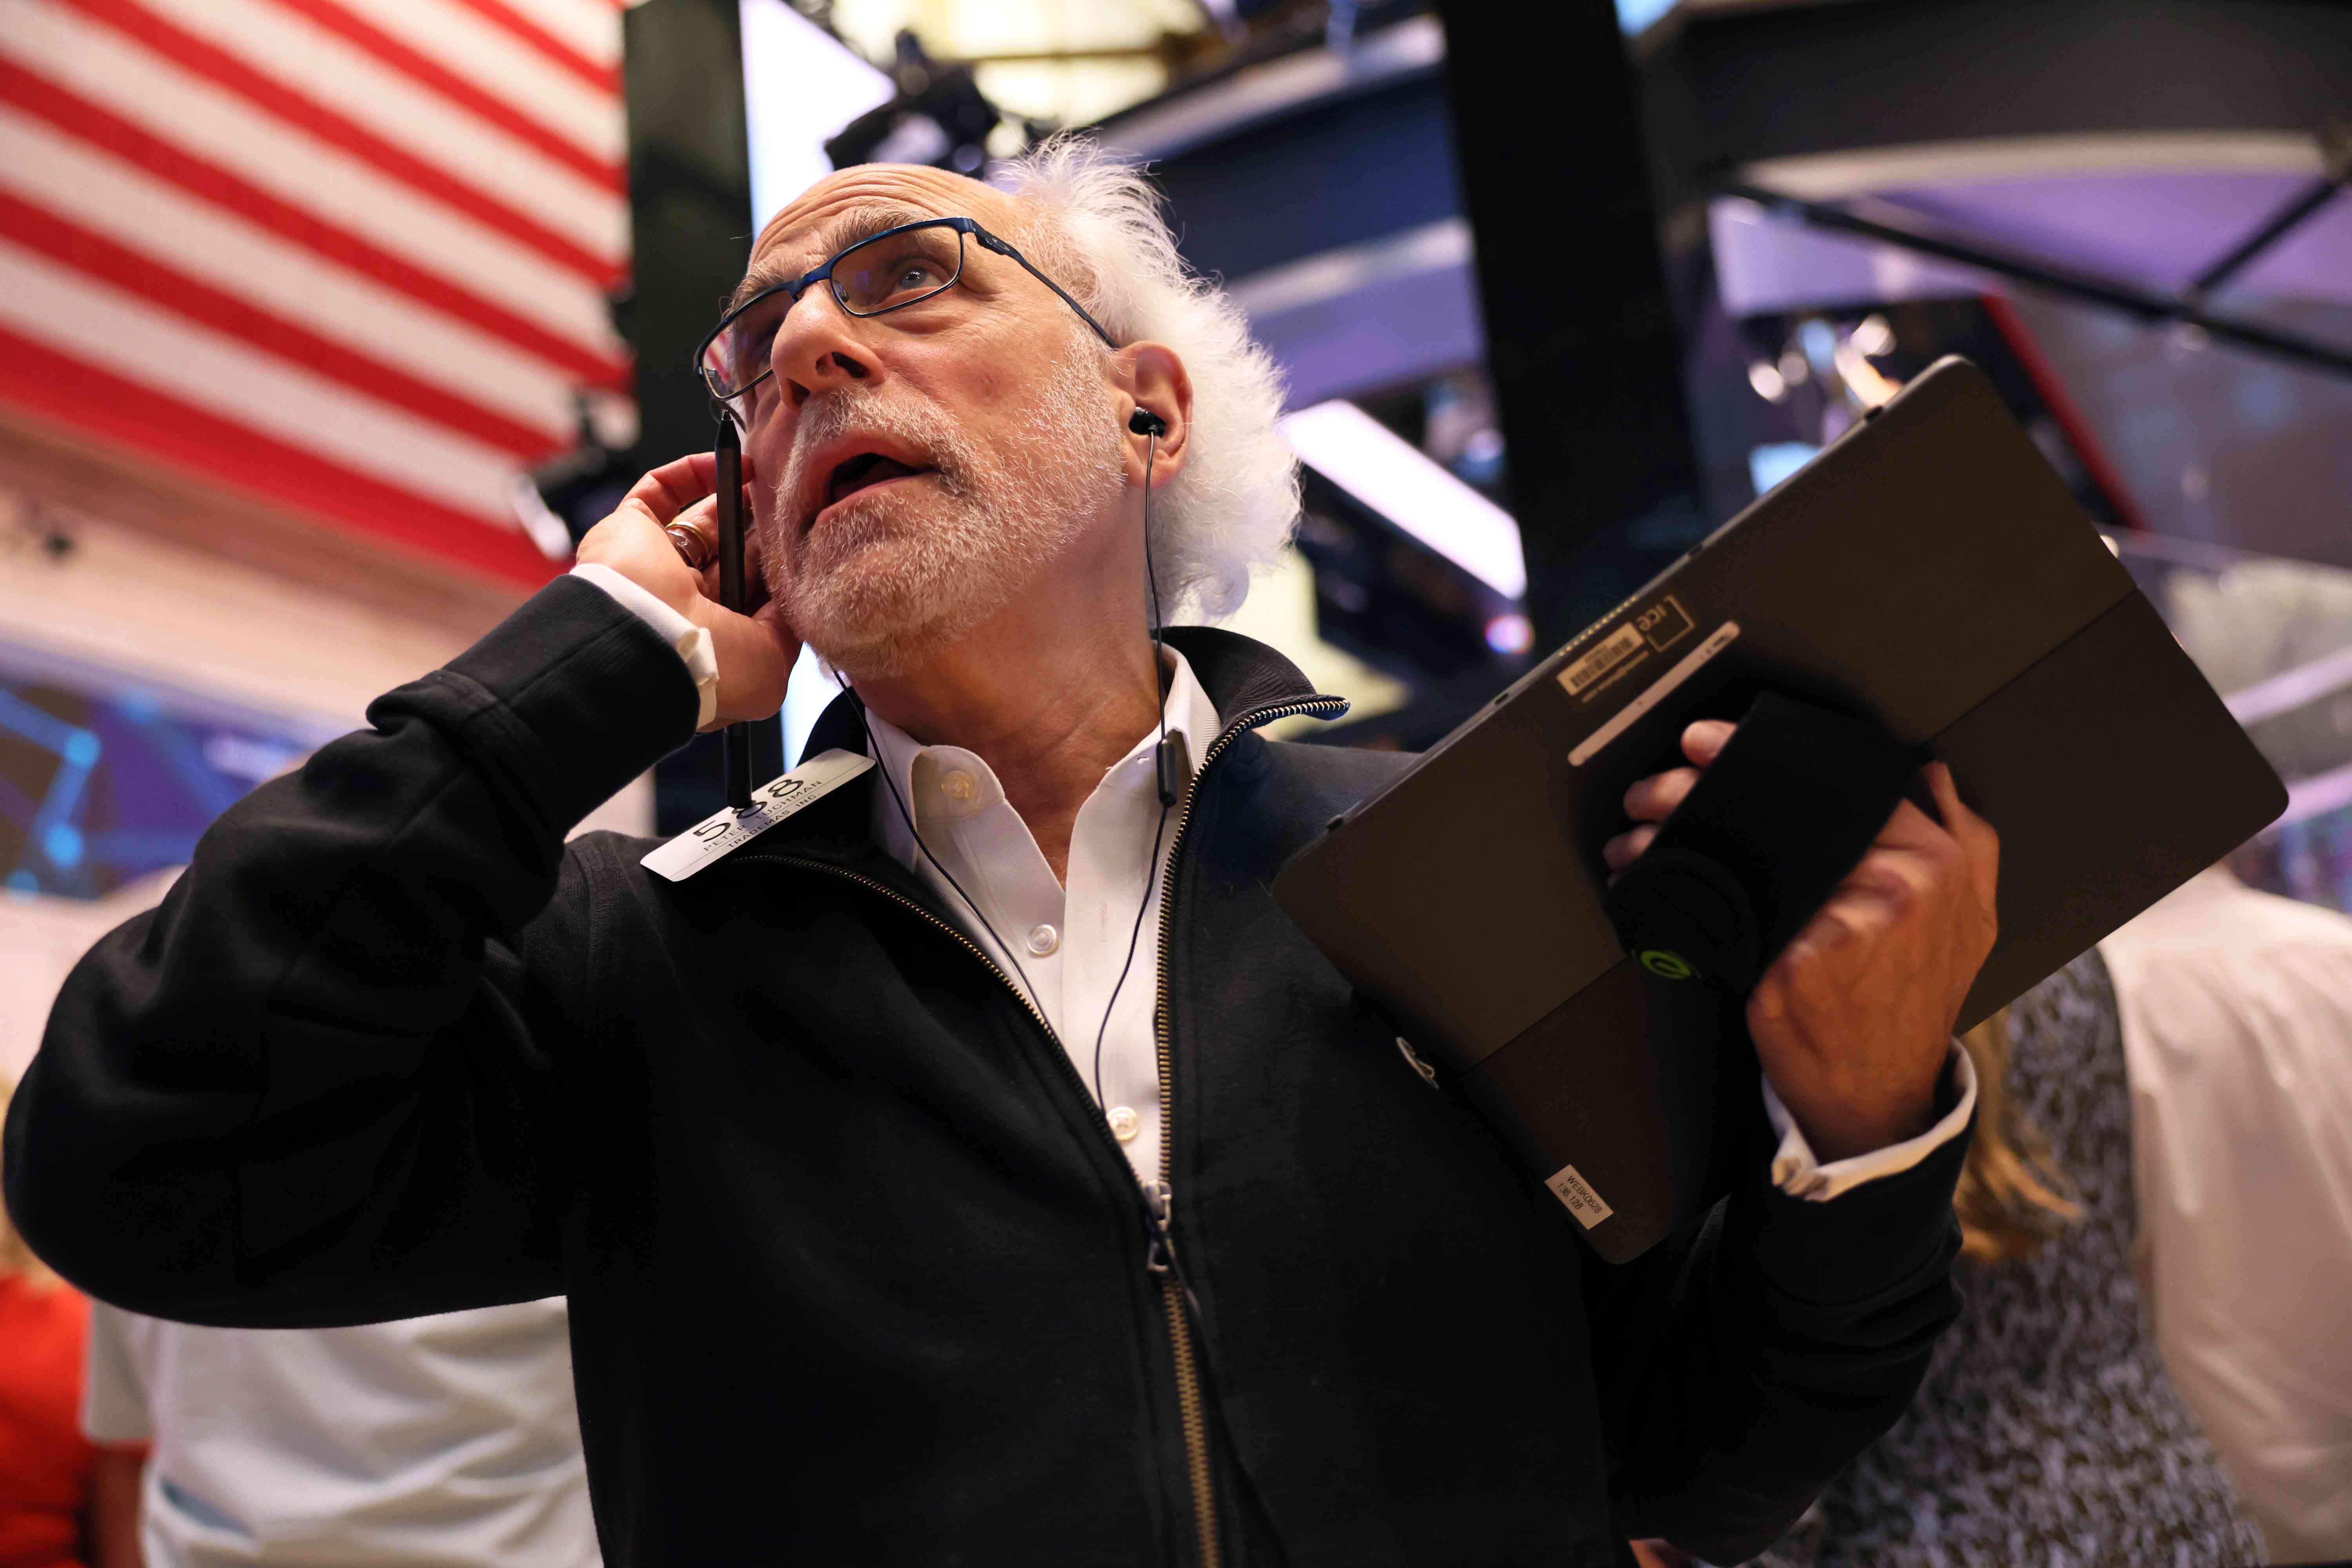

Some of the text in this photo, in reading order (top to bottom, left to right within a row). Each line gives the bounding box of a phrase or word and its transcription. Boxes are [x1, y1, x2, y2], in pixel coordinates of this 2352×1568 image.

[693, 779, 804, 842] 588
[703, 781, 822, 851] PETER TUCHMAN
[727, 794, 820, 847] TRADEMAS INC.
